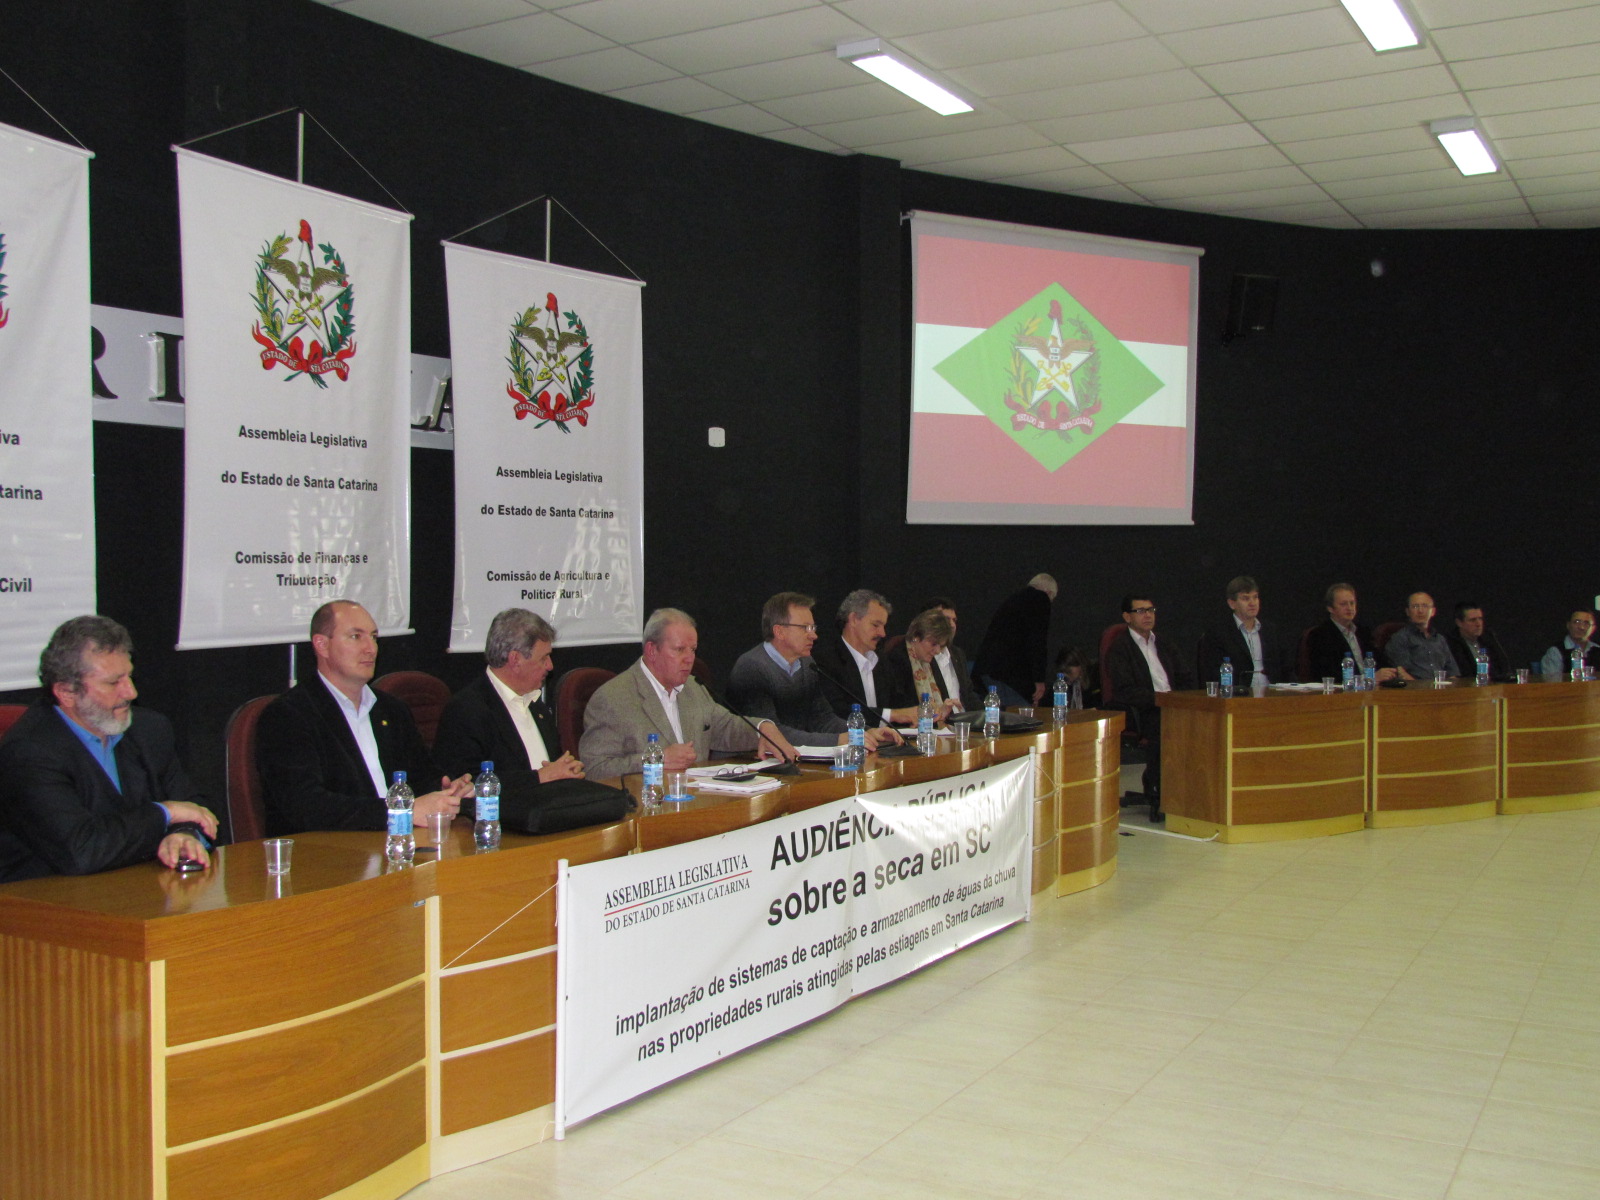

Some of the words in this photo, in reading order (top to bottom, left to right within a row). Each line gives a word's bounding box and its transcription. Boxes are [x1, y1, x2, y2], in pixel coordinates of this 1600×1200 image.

[288, 359, 297, 368] DE
[238, 425, 307, 443] Assembleia
[310, 432, 368, 449] Legislativa
[221, 470, 237, 484] do
[241, 471, 283, 486] Estado
[286, 474, 300, 487] de
[303, 475, 335, 489] Santa
[338, 477, 378, 492] Catarina
[496, 466, 552, 480] Assembleia
[555, 470, 603, 483] Legislativa
[481, 504, 494, 515] do
[498, 504, 533, 516] Estado
[535, 506, 547, 517] de
[549, 506, 576, 518] Santa
[578, 508, 614, 519] Catarina
[235, 551, 294, 564] Comissão
[297, 551, 312, 564] de
[315, 551, 361, 567] Finanças
[362, 553, 369, 564] e
[0, 577, 33, 593] Civil
[276, 574, 337, 589] Tributação
[486, 570, 537, 582] Comissão
[539, 570, 551, 581] de
[554, 570, 603, 583] Agricultura
[604, 572, 610, 580] e
[560, 588, 583, 599] Rural
[604, 874, 676, 910] ASSEMBLEIA
[679, 854, 749, 888] LEGISLATIVA
[767, 876, 847, 927] sobre
[852, 870, 866, 898] a
[874, 852, 924, 890] seca
[930, 838, 960, 871] em
[965, 823, 991, 859] SC
[605, 917, 621, 933] DO
[623, 904, 660, 928] ESTADO
[662, 900, 675, 915] DE
[676, 892, 706, 911] SANTA
[707, 877, 751, 901] CATARINA
[615, 985, 704, 1036] implantação
[708, 976, 725, 997] de
[729, 954, 788, 989] sistemas
[791, 946, 807, 966] de
[810, 926, 857, 960] captação
[860, 923, 867, 937] e
[870, 894, 940, 935] armazenamento
[942, 888, 955, 903] de
[956, 879, 982, 902] águas
[983, 873, 993, 890] da
[994, 865, 1016, 885] chuva
[637, 1036, 665, 1062] nas
[669, 997, 763, 1053] propriedades
[766, 978, 804, 1009] rurais
[807, 958, 853, 993] atingidas
[856, 945, 887, 974] pelas
[889, 926, 930, 958] estiagens
[931, 920, 944, 937] em
[945, 908, 968, 930] Santa
[970, 895, 1004, 919] Catarina
